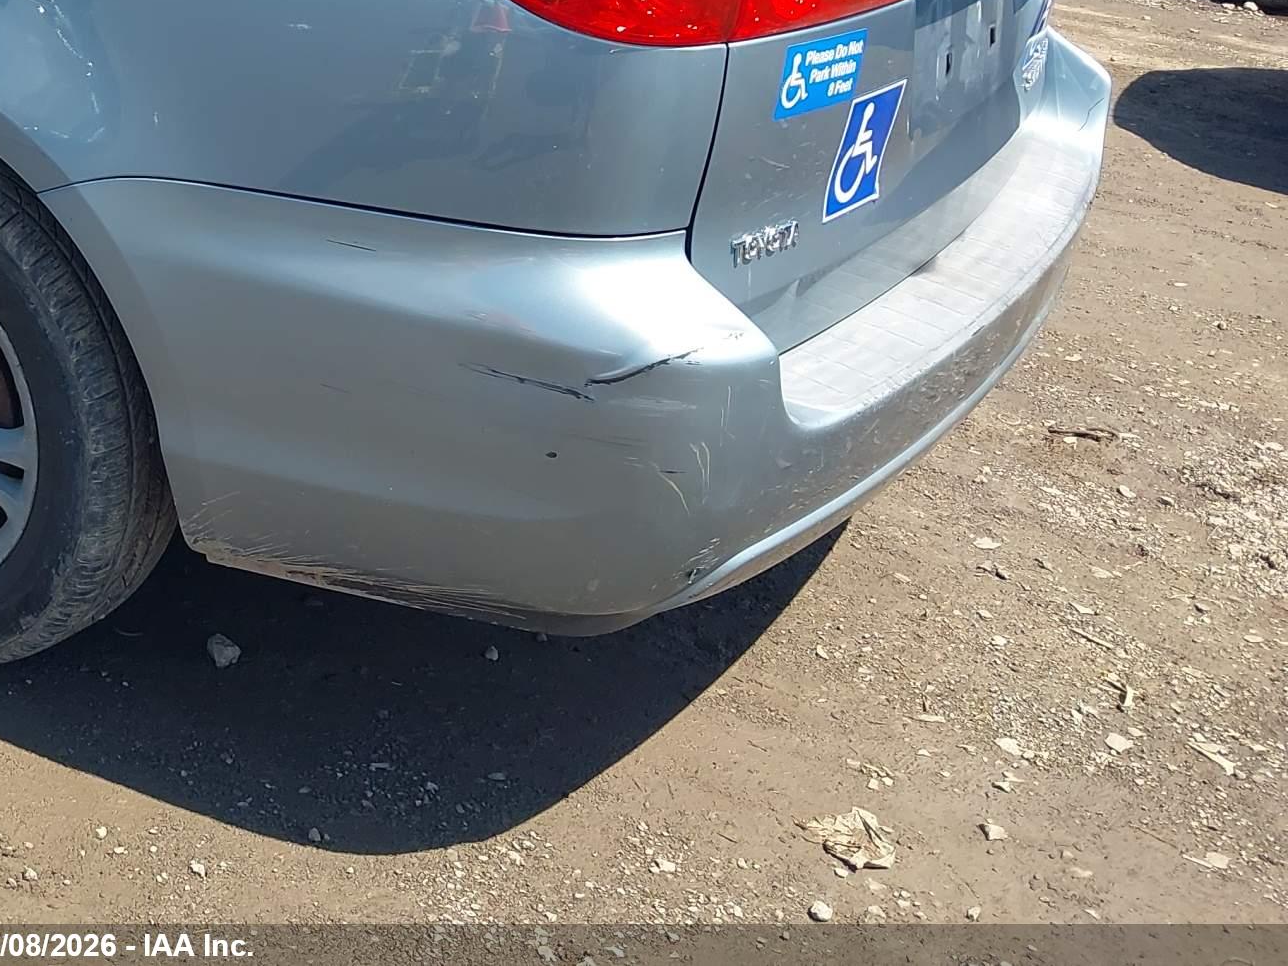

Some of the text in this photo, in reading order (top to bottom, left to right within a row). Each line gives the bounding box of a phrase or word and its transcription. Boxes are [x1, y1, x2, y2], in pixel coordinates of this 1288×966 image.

[805, 39, 864, 66] Please Do Not
[809, 59, 857, 84] Park Within
[834, 77, 854, 95] Feet
